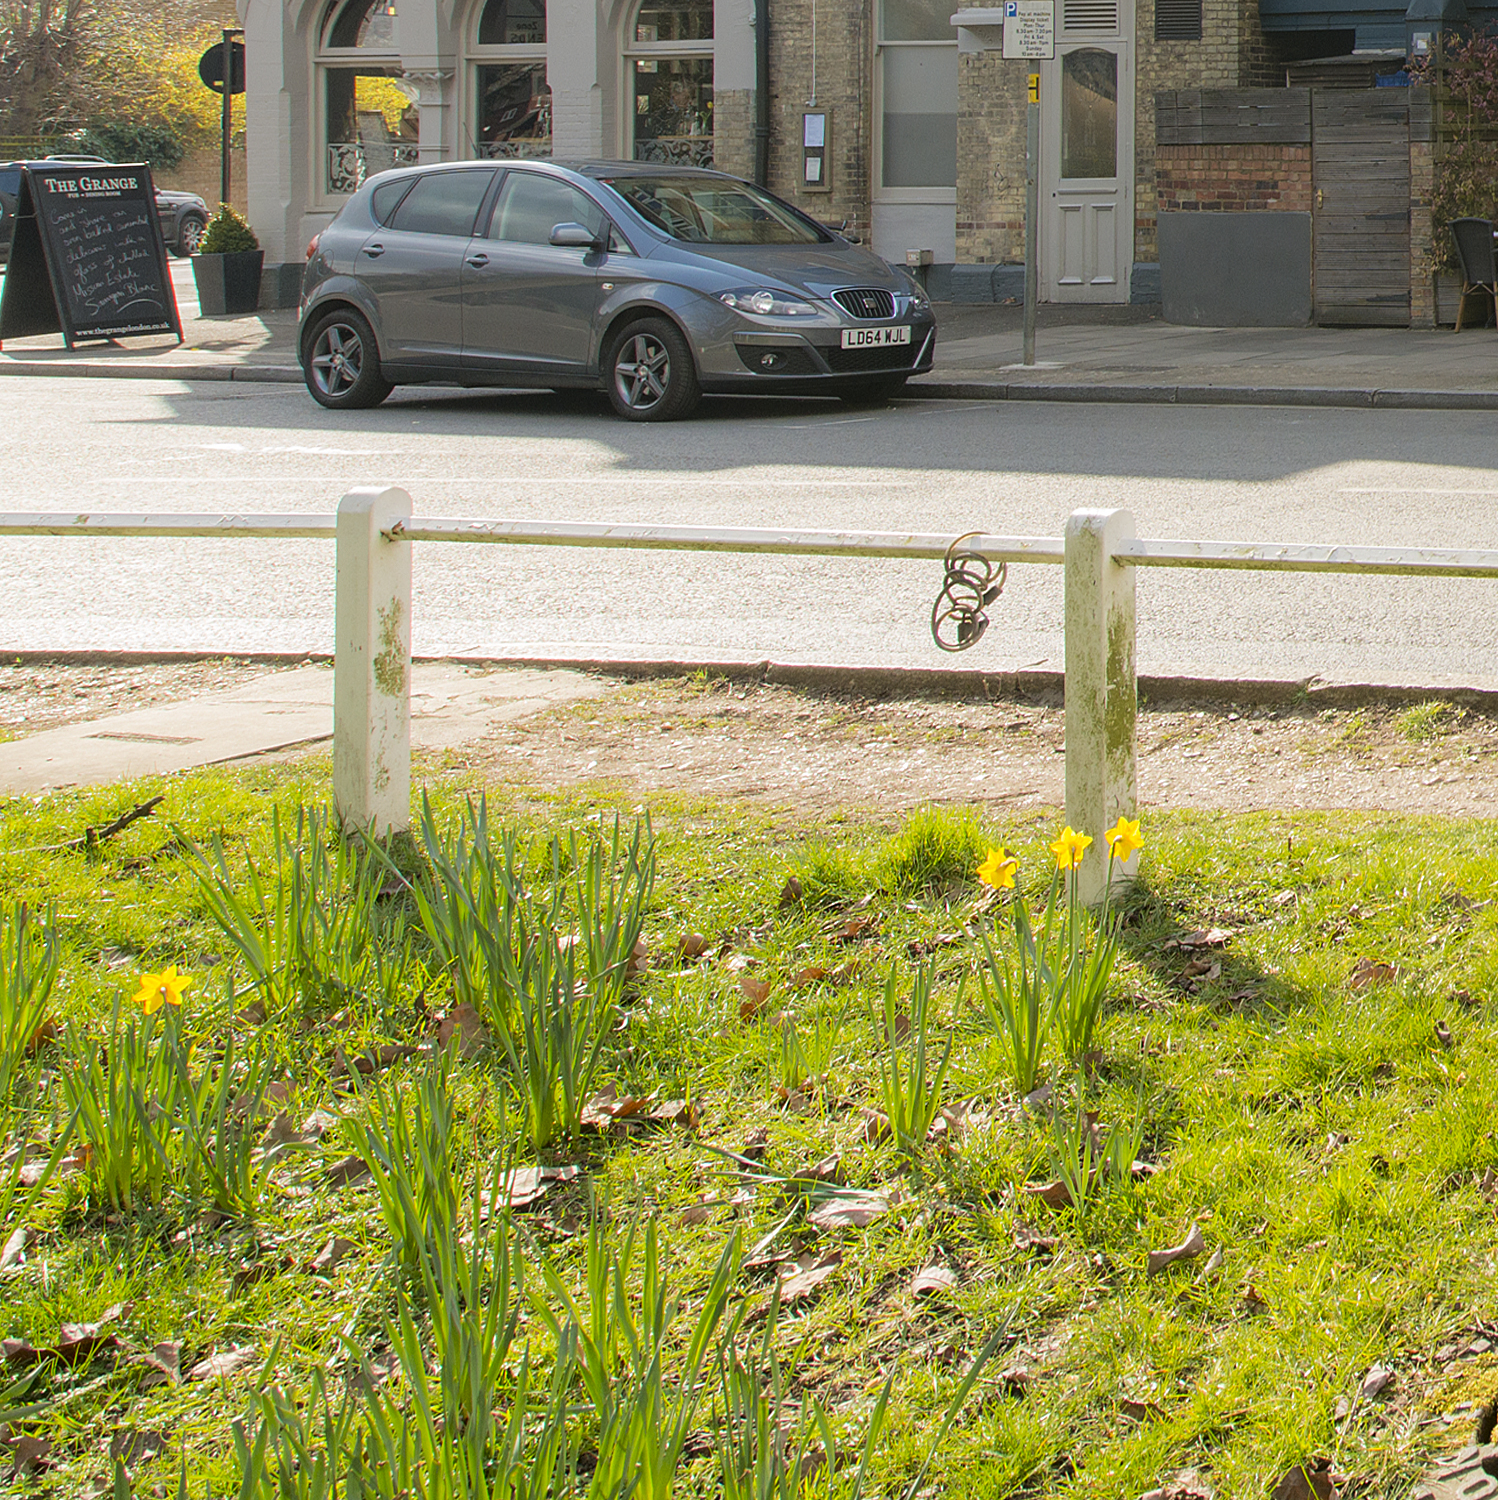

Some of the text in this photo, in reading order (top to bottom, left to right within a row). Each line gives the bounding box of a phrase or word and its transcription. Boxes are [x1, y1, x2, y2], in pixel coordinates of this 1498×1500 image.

[1006, 2, 1016, 17] P
[44, 176, 138, 192] THE GRANGE
[59, 222, 76, 235] and
[104, 255, 115, 270] of
[75, 322, 171, 337] www.thegrangelondon.co.uk
[848, 328, 906, 346] LD64 WJL
